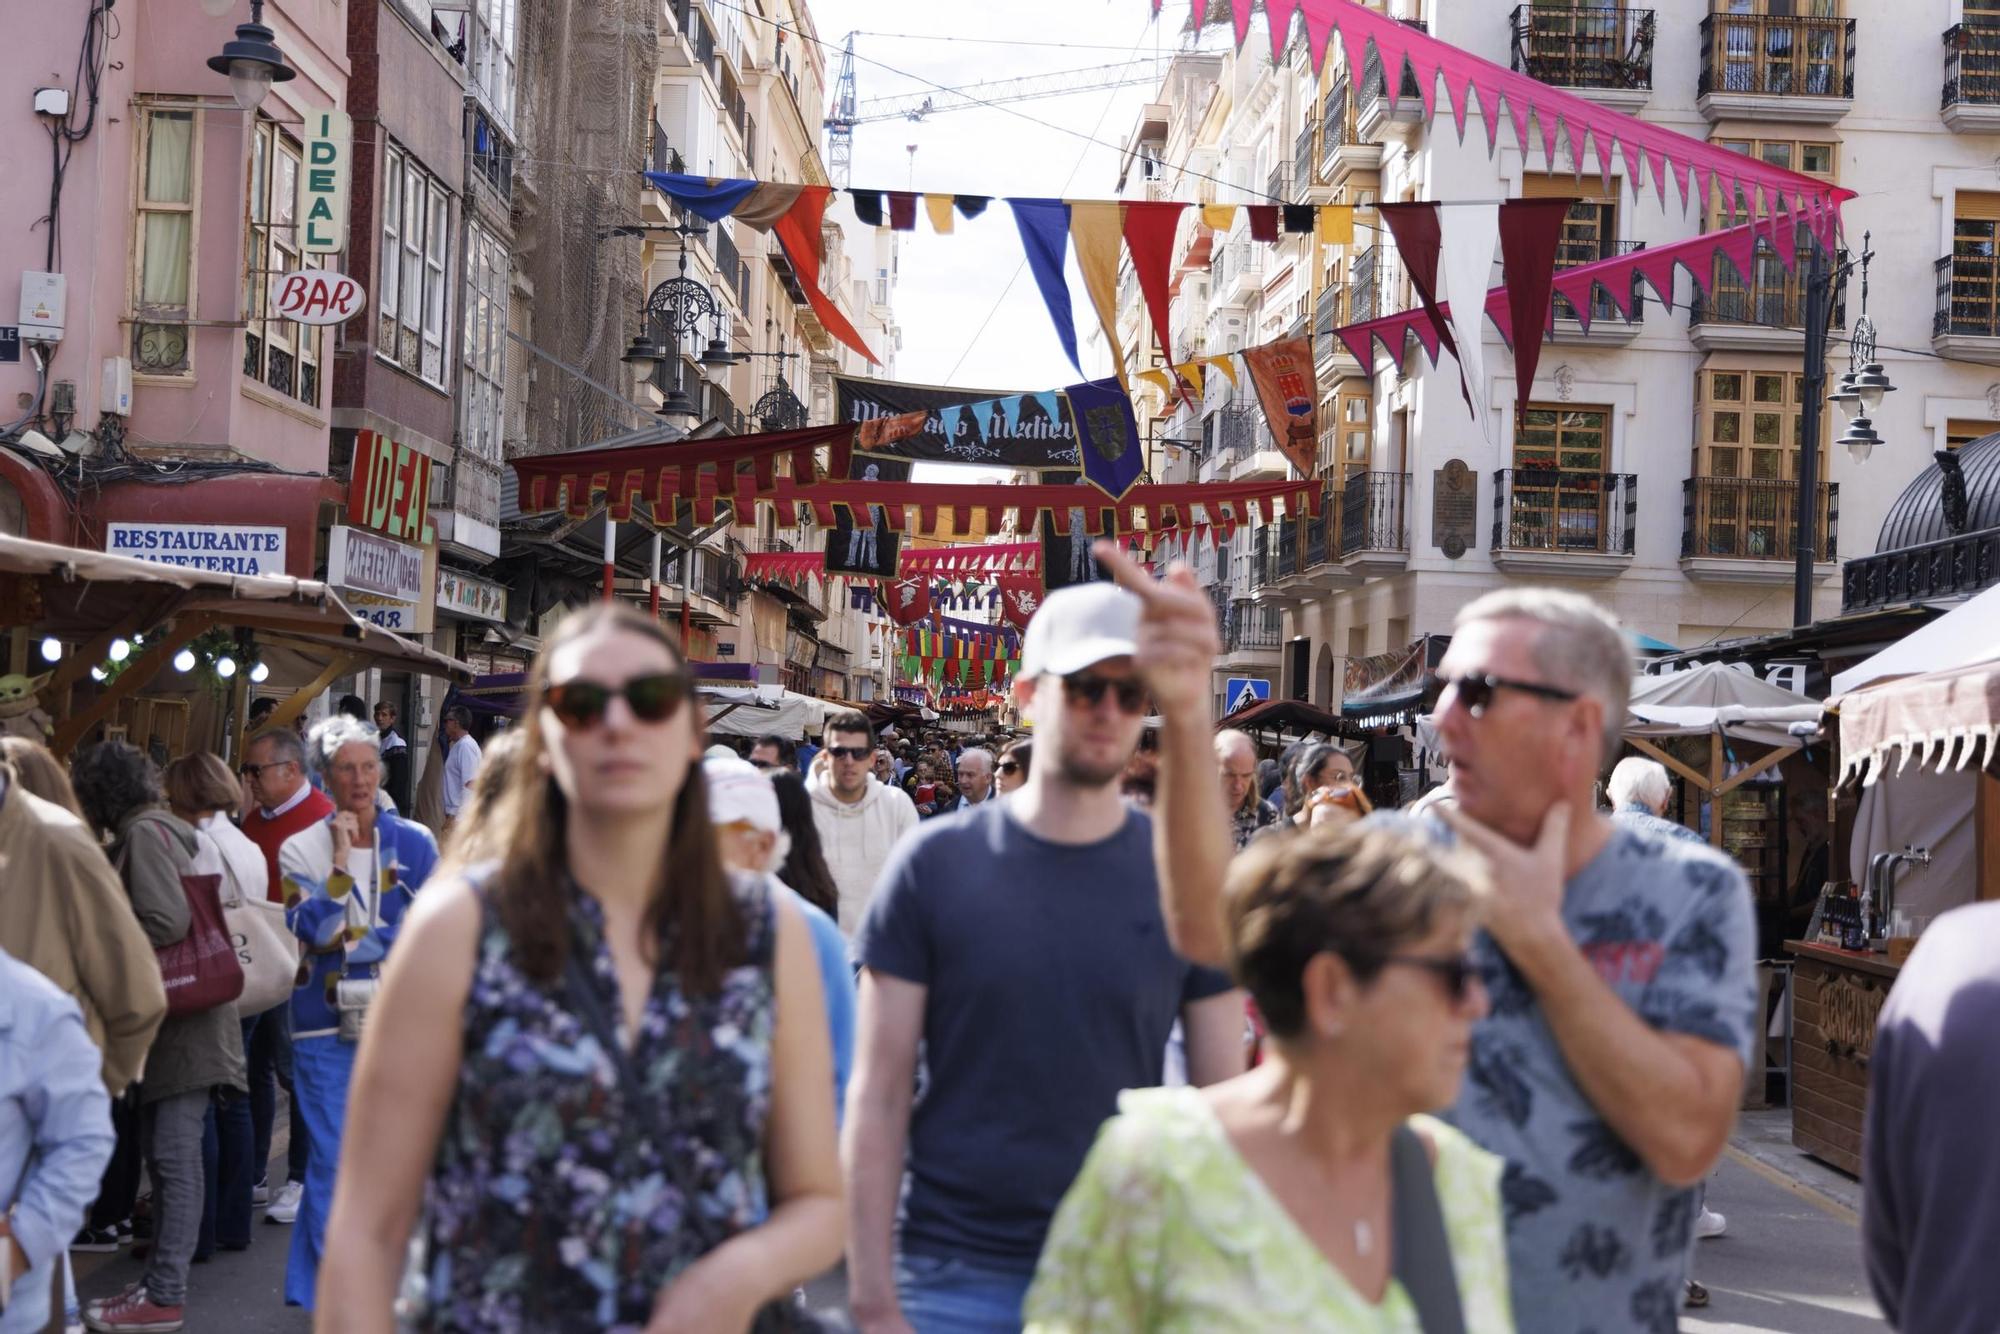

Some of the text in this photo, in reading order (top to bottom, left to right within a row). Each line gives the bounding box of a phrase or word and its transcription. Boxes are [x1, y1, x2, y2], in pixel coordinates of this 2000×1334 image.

[307, 114, 337, 246] IDEAL
[279, 276, 355, 317] BAR
[362, 431, 434, 545] IDEAL
[113, 529, 280, 552] RESTAURANTE
[346, 537, 399, 588] CAFETERIA
